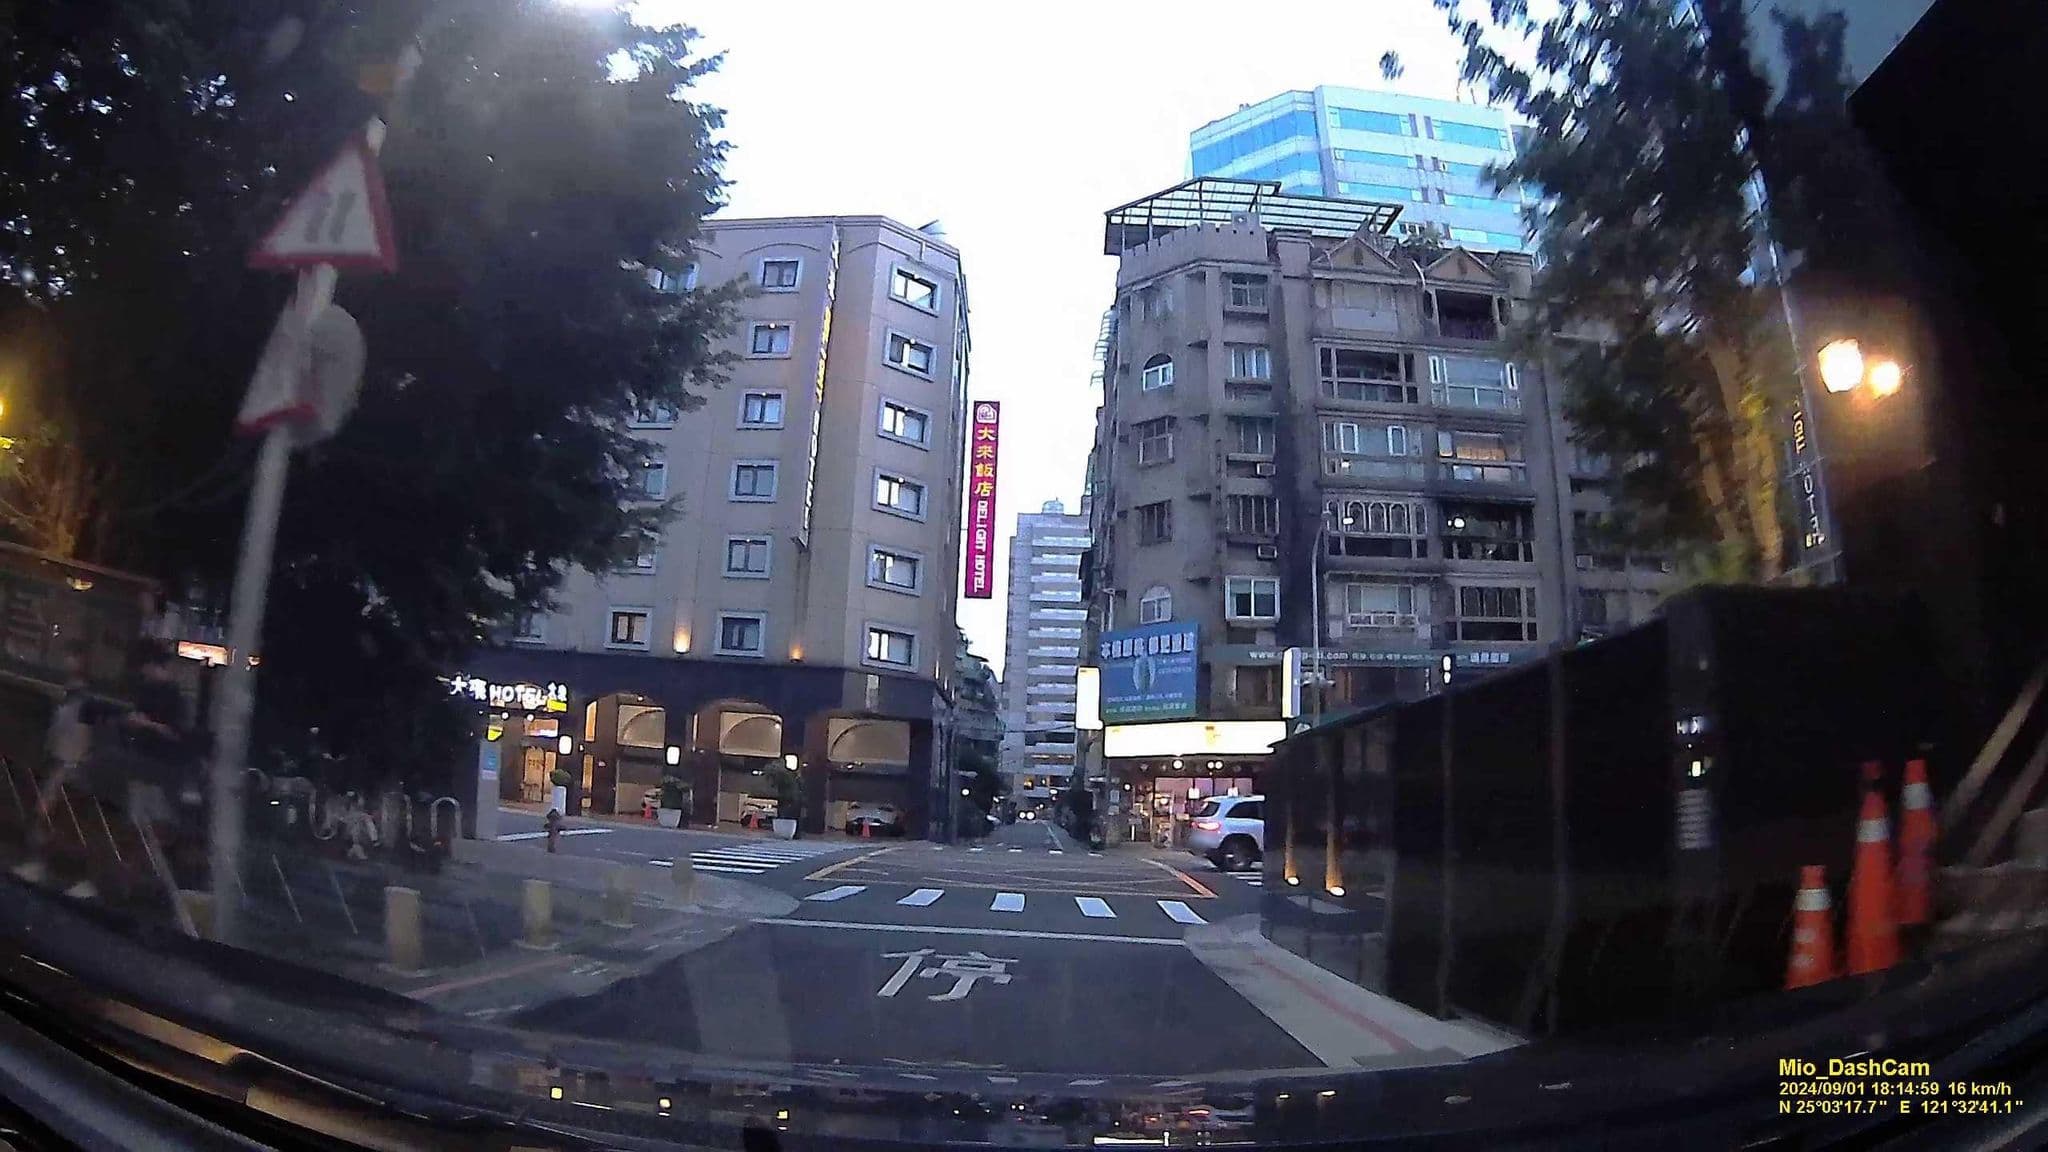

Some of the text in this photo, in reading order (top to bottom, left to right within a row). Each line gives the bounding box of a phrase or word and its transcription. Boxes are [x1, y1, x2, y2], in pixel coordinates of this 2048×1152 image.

[974, 500, 988, 593] DELIGHT HOTEL
[489, 684, 547, 707] HOTEL
[877, 949, 1019, 1001] 停
